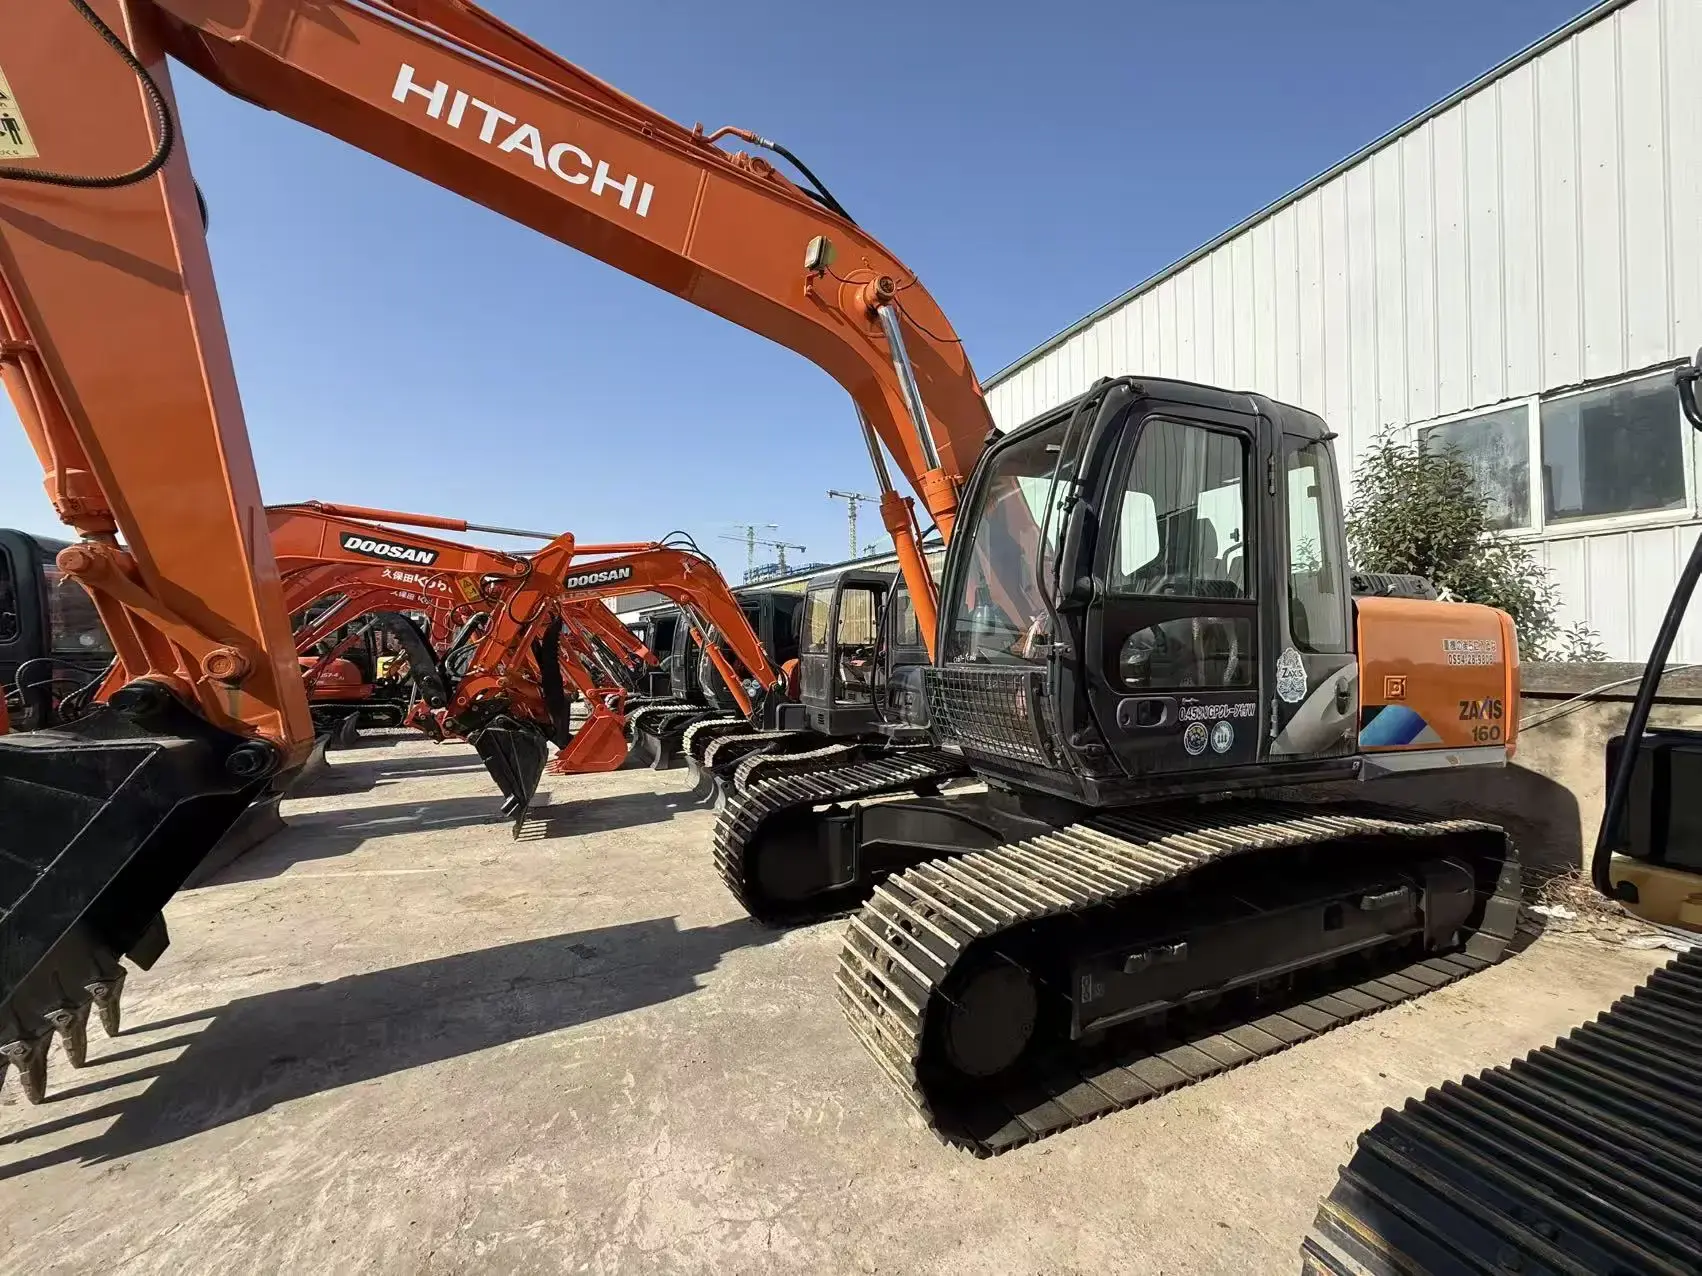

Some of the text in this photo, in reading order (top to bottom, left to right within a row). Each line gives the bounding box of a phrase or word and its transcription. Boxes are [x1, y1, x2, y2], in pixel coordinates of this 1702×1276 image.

[391, 63, 655, 217] HITACHI
[344, 537, 434, 564] DOOSAN
[382, 568, 414, 584] 久保田
[567, 567, 630, 588] DOOSAN
[1459, 696, 1502, 720] ZAXIS
[1472, 725, 1501, 742] 160
